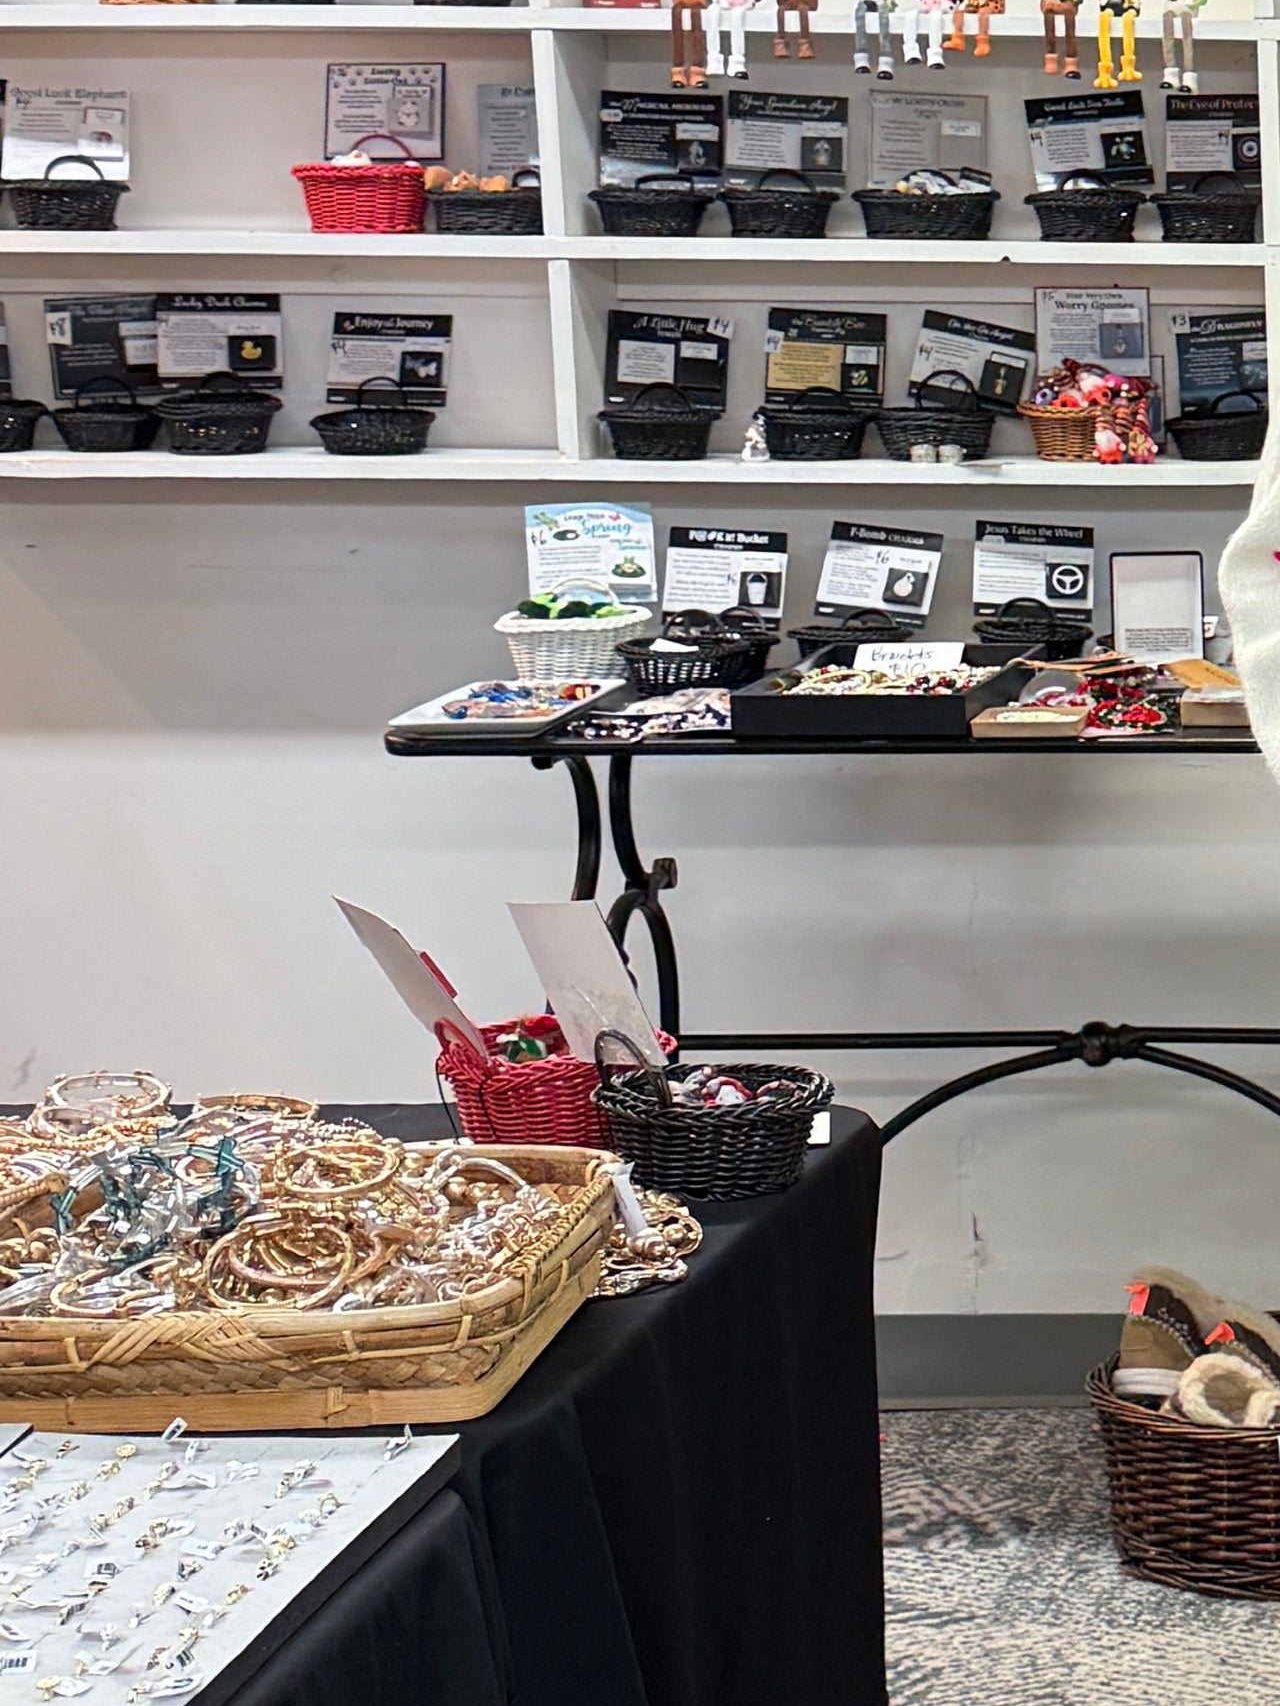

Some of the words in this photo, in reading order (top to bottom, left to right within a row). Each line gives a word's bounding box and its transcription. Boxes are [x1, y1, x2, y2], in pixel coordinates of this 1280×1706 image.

[1170, 98, 1189, 110] The
[1189, 98, 1208, 111] Eye
[1208, 98, 1220, 110] of
[1053, 300, 1088, 313] Worry
[353, 315, 382, 330] Enjoy
[396, 317, 434, 331] Journey
[678, 319, 706, 335] Hug
[712, 316, 730, 334] $4
[581, 519, 633, 537] Spring
[849, 526, 887, 541] F-Bomb
[984, 523, 1009, 536] Jesus
[1010, 524, 1037, 536] Takes
[1037, 527, 1054, 538] the
[1053, 528, 1084, 540] Wheel
[530, 529, 547, 547] $6
